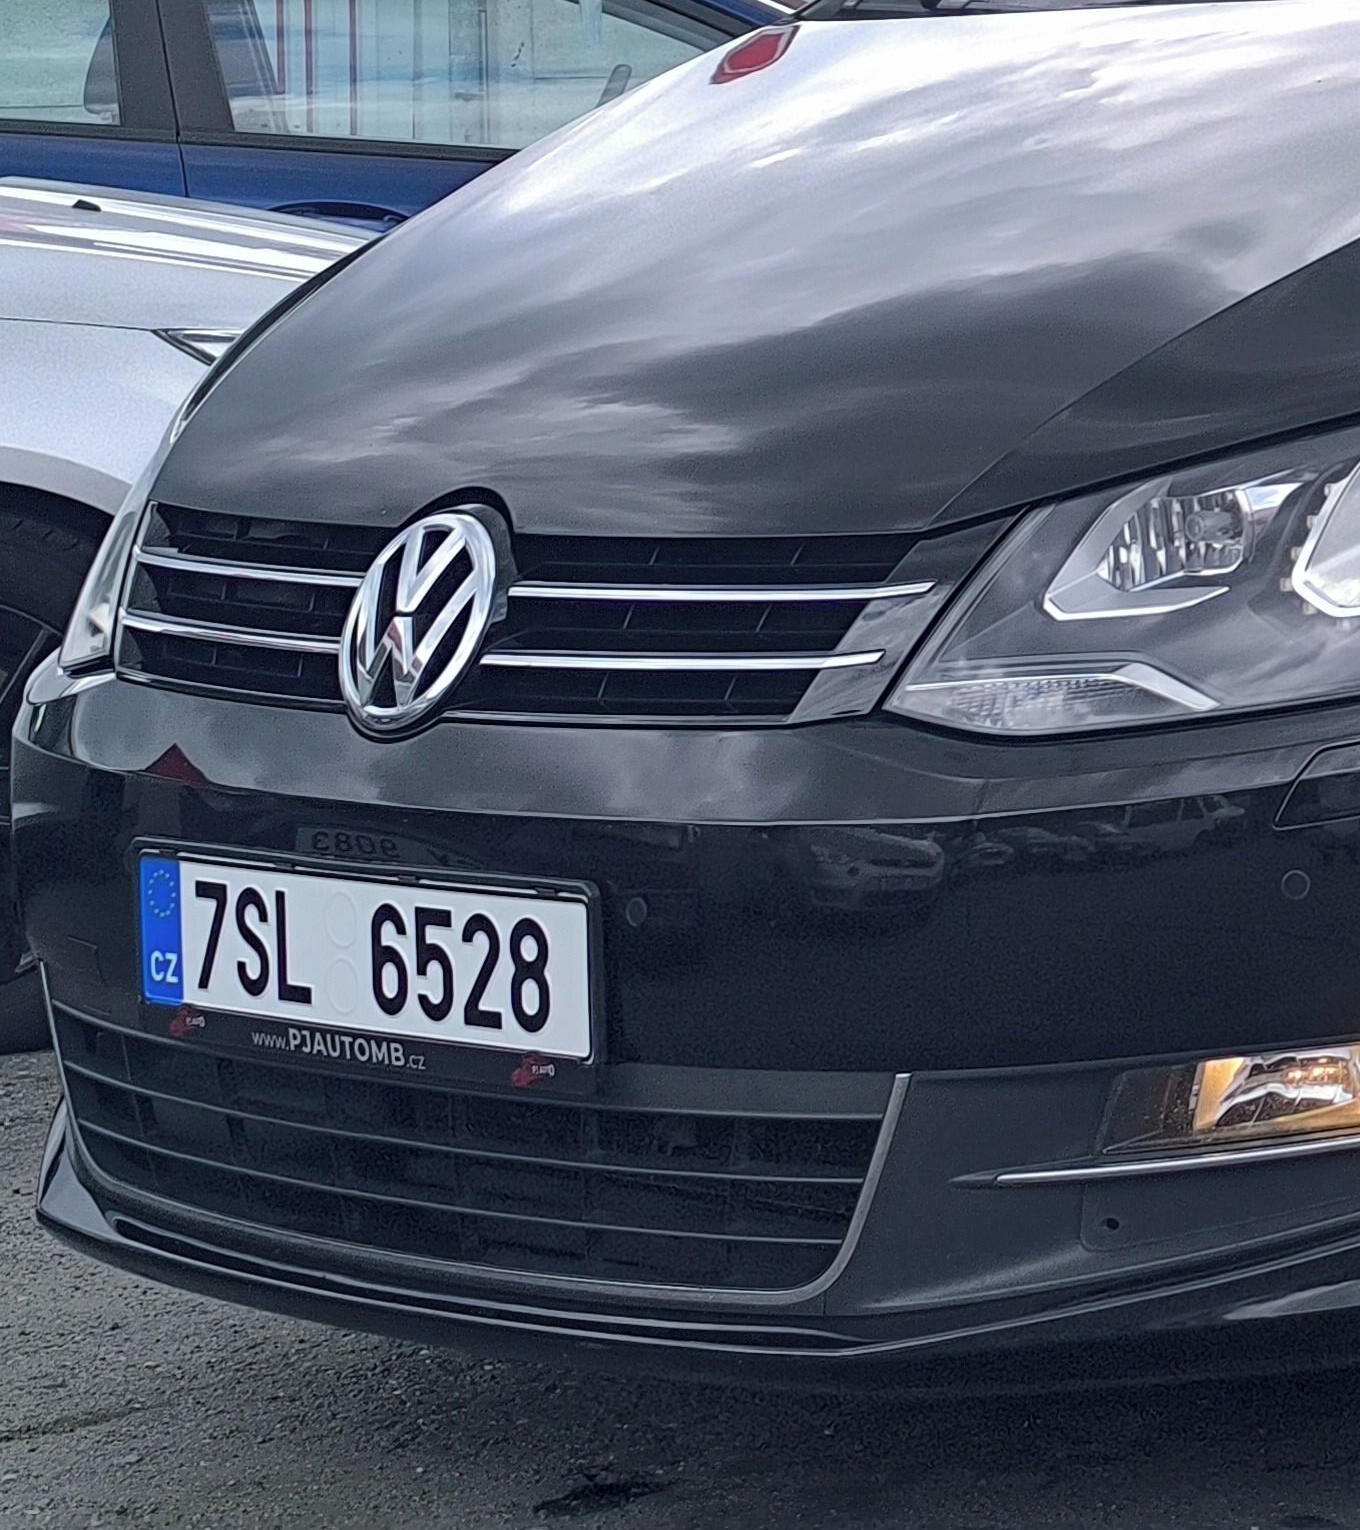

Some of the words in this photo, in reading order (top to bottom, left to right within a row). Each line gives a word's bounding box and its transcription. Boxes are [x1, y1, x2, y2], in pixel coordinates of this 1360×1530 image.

[149, 950, 180, 984] CZ
[195, 879, 313, 1005] 7SL
[370, 902, 551, 1033] 6528
[250, 1027, 426, 1070] www.PJAUTOMB.cz
